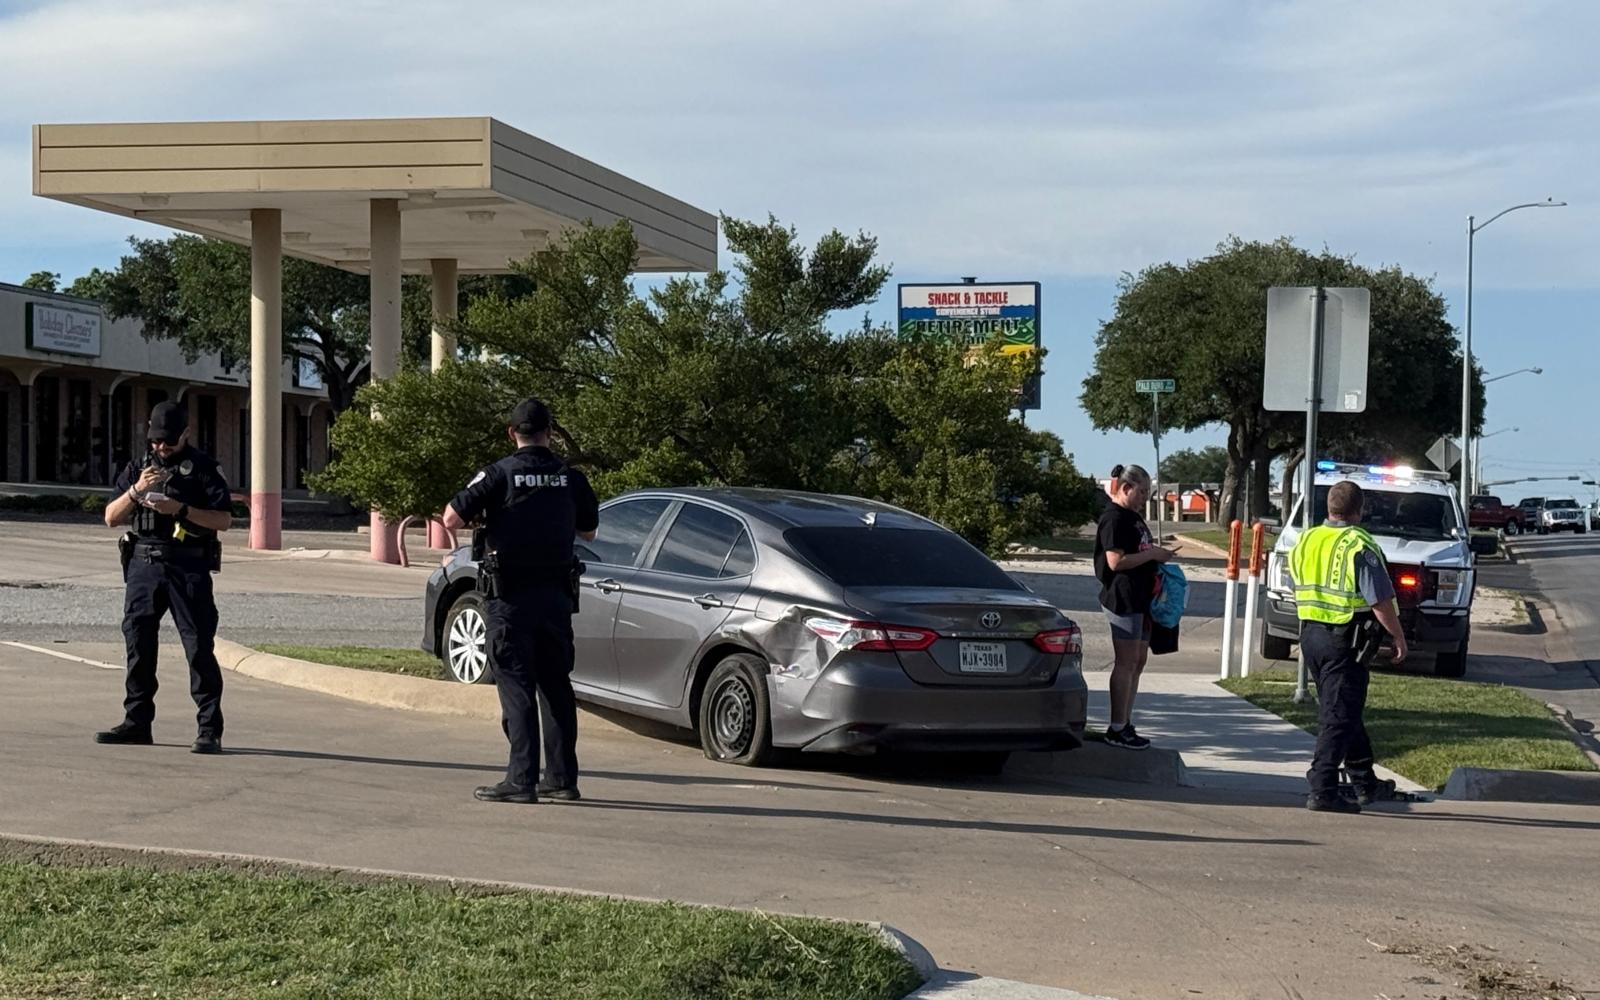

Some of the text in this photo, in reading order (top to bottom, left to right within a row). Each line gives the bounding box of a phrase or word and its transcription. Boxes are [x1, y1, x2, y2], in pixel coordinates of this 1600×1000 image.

[928, 291, 1009, 306] SNACK & TACKLE
[915, 318, 1020, 334] RETIREMENT
[514, 474, 568, 487] POLICE
[974, 644, 993, 652] TEXAS
